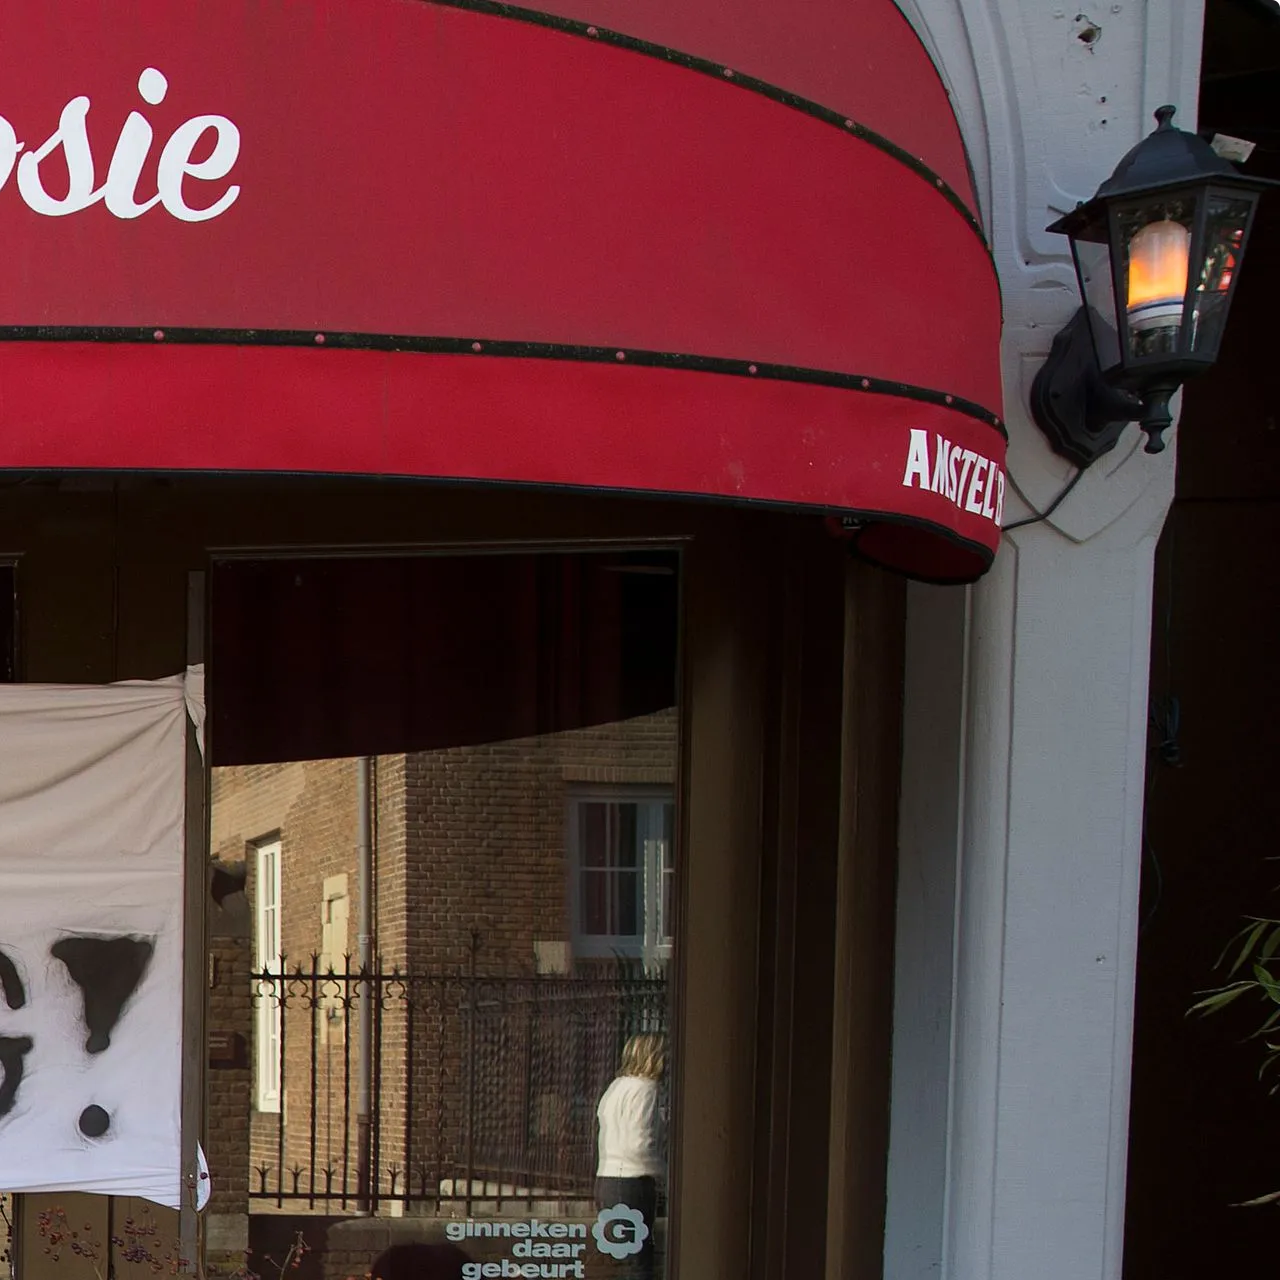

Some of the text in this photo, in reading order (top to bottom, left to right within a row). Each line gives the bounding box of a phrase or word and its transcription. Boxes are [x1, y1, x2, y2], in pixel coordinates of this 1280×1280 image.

[902, 428, 998, 520] AMSTEL
[446, 1218, 587, 1241] ginneken
[602, 1218, 637, 1244] G
[512, 1239, 586, 1258] daar
